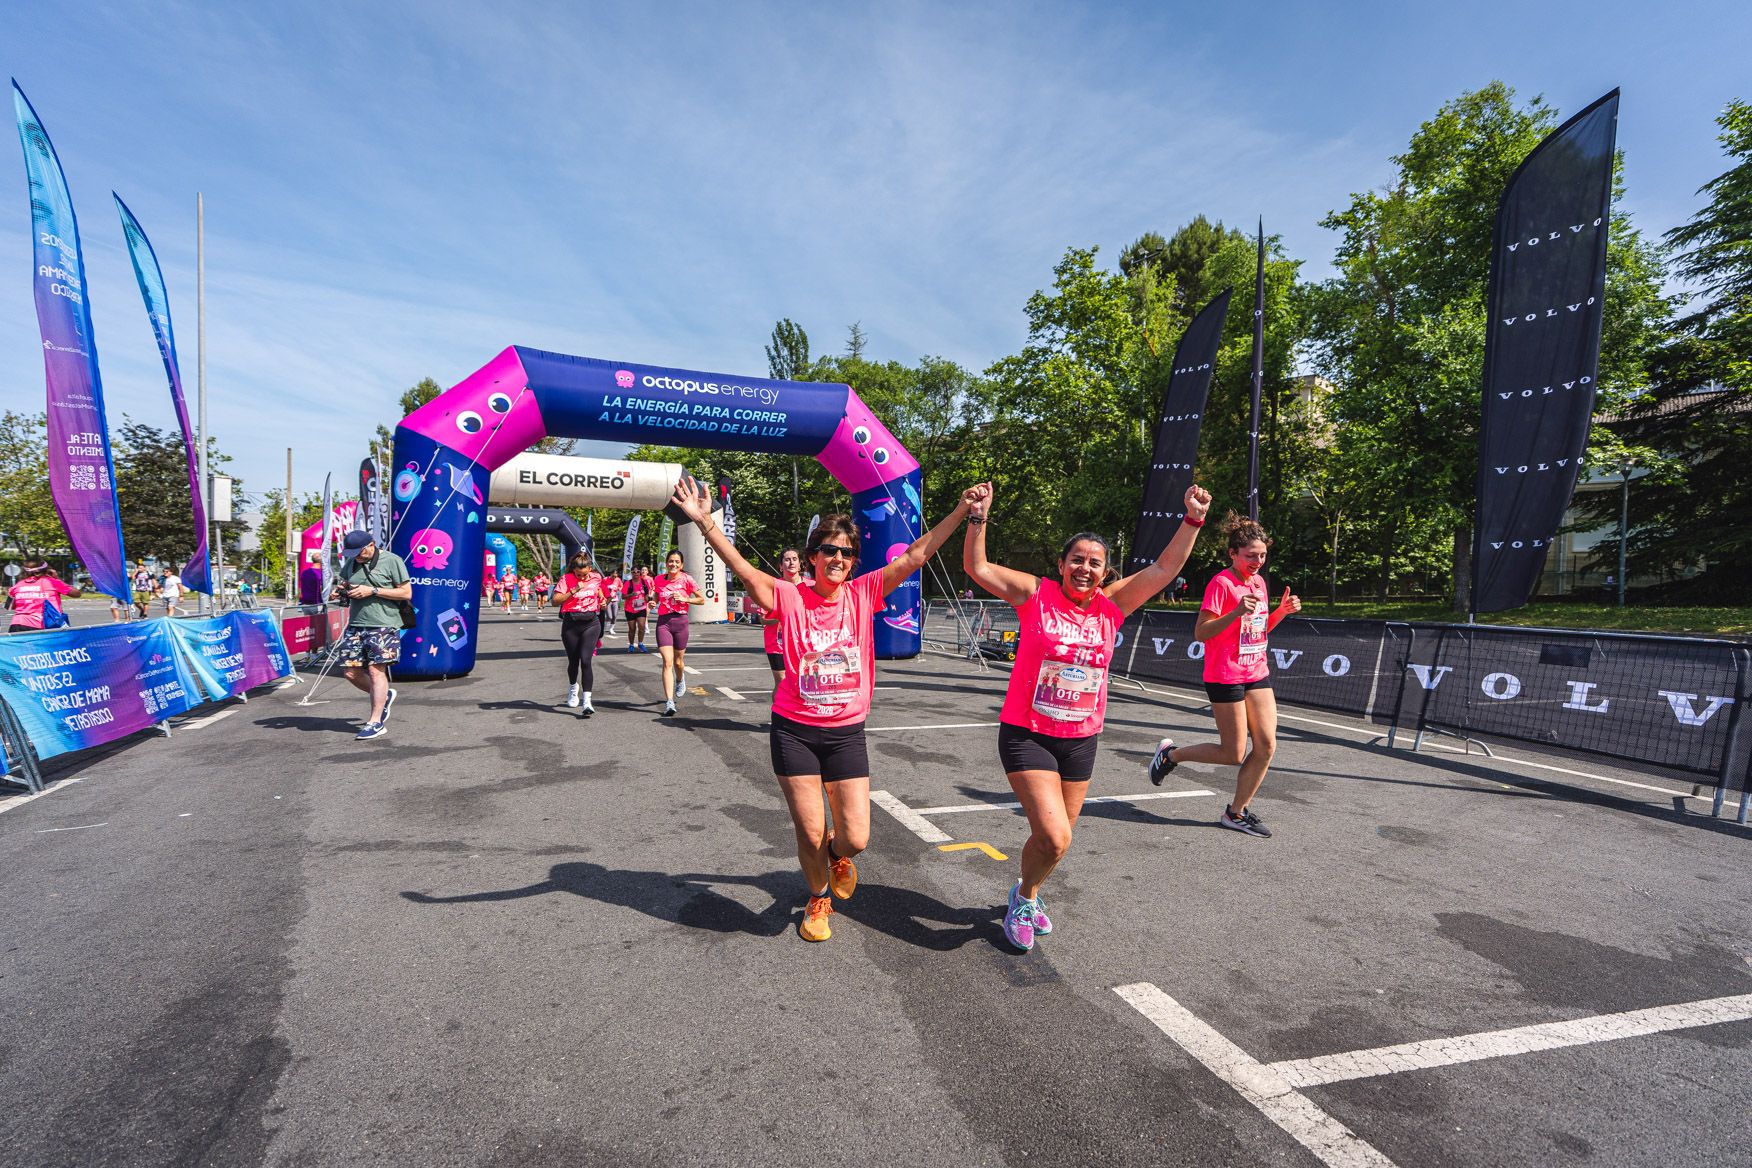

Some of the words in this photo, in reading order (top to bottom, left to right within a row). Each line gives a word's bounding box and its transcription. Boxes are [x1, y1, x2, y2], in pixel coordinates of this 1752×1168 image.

[1507, 217, 1602, 252] VOLVO
[1503, 296, 1595, 326] VOLVO
[642, 375, 719, 395] octopus
[720, 384, 780, 405] energy
[1499, 375, 1591, 400] VOLVO
[602, 395, 622, 408] LA
[626, 397, 689, 415] ENERGÍA
[692, 405, 730, 419] PARA
[733, 409, 787, 424] CORRER
[598, 412, 610, 422] A
[613, 412, 633, 424] LA
[638, 415, 718, 432] VELOCIDAD
[720, 423, 738, 434] DE
[741, 424, 758, 435] LA
[761, 426, 788, 437] LUZ
[1495, 456, 1583, 475] VOLVO
[519, 470, 543, 485] EL
[546, 472, 624, 490] CORREO
[486, 514, 550, 524] OLVO
[627, 519, 638, 561] AMUTIO
[1490, 538, 1553, 550] VOL
[704, 546, 715, 599] CORREO
[1133, 557, 1155, 565] VOL
[431, 578, 470, 590] energy
[1152, 637, 1351, 677] VOVO
[820, 675, 843, 685] 016
[70, 691, 84, 709] DE
[85, 685, 111, 704] MAMA
[1056, 689, 1081, 701] 016
[1406, 663, 1735, 726] VOLV
